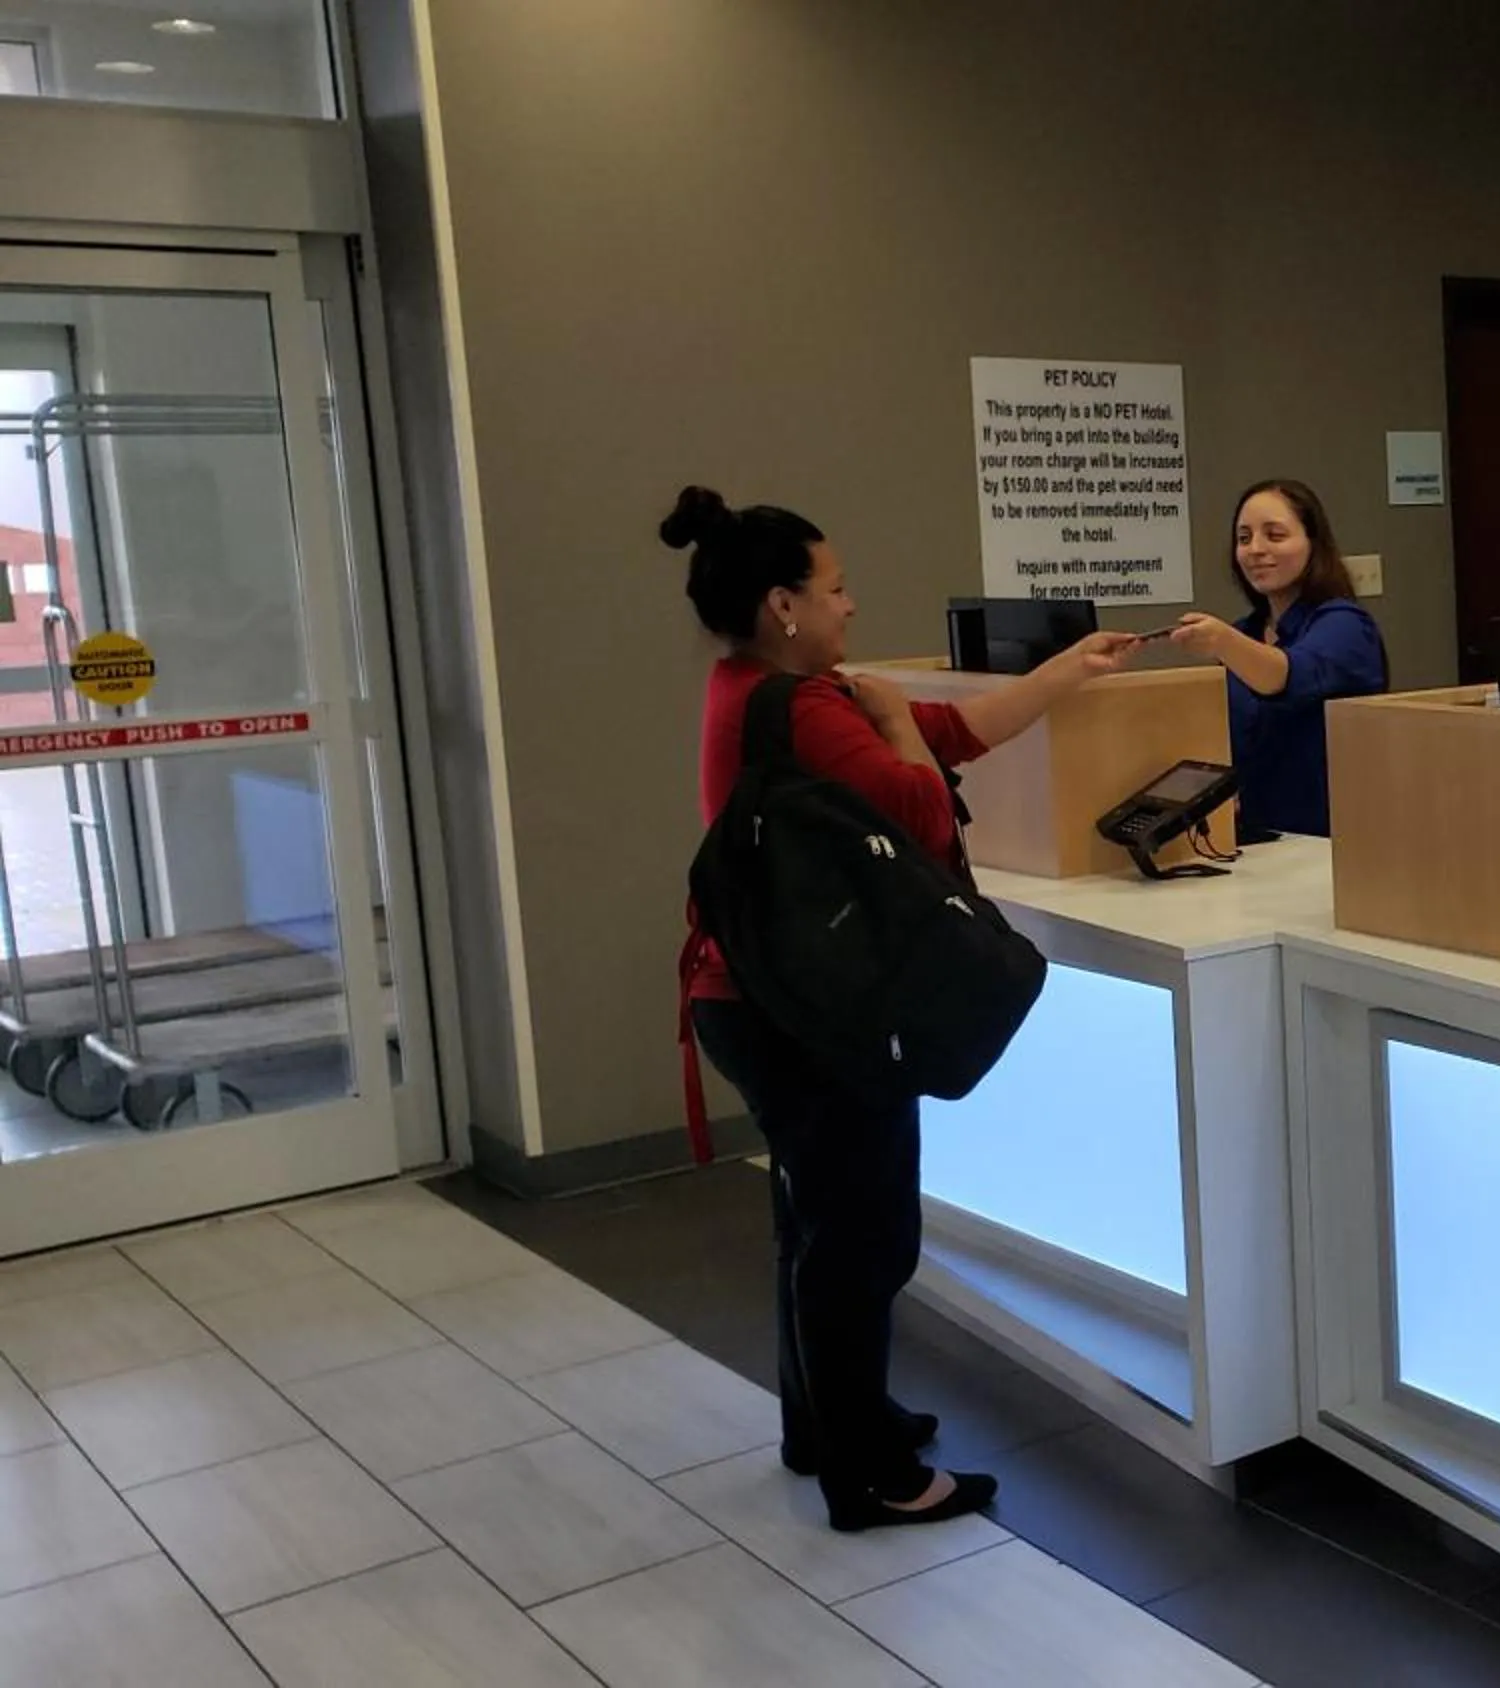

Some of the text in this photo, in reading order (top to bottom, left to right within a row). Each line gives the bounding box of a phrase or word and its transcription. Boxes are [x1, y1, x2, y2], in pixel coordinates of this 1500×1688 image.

[1044, 369, 1117, 388] PET POLICY
[986, 399, 1174, 422] This property is a NO PET Hotel.
[983, 426, 1179, 448] If you bring a pet into the building
[980, 453, 1184, 472] your room charge will be increased
[983, 476, 1183, 496] by $150.00 and the pet would need
[992, 501, 1179, 521] to be removed immediately from
[1061, 525, 1117, 543] the hotel.
[1017, 556, 1163, 577] Inquire with management
[1029, 579, 1153, 599] for more information.
[74, 662, 151, 679] CAUTION
[126, 726, 184, 745] PUSH
[198, 721, 226, 738] TO
[239, 714, 296, 734] OPEN
